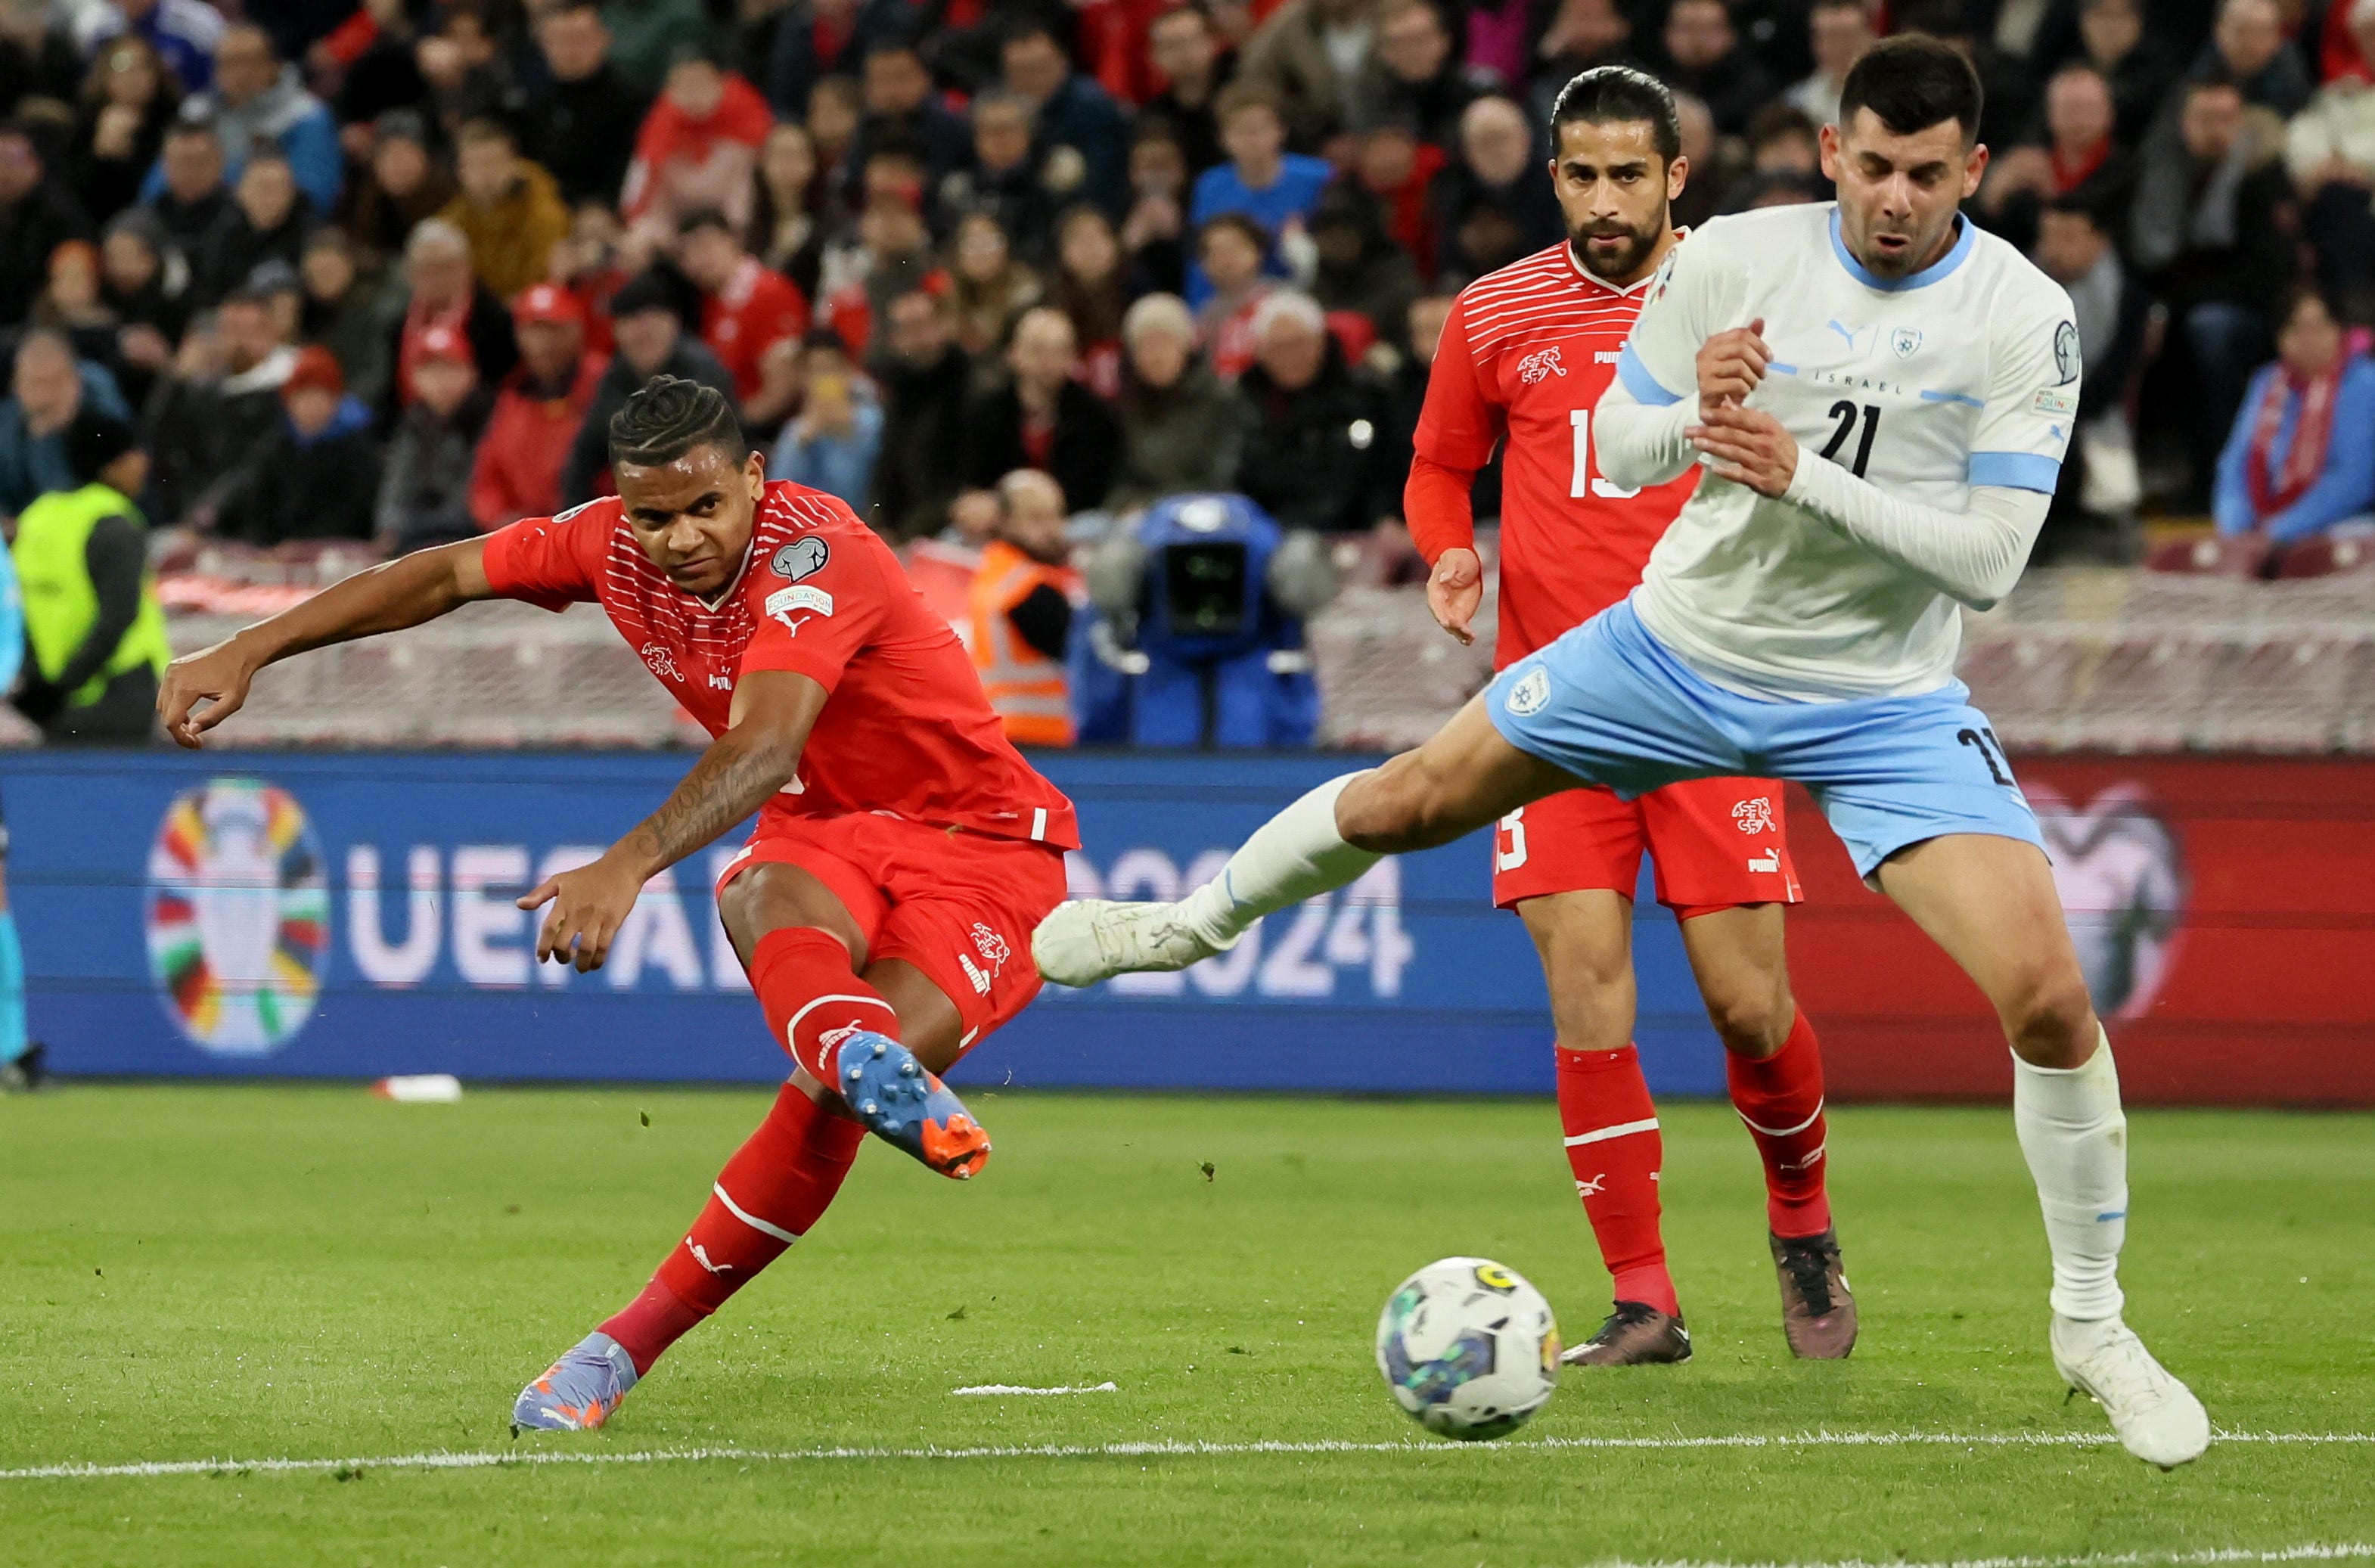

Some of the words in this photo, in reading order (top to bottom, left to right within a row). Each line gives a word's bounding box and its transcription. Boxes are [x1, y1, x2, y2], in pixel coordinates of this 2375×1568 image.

[1594, 351, 1622, 364] PUM
[1815, 369, 1902, 396] ISRAEL
[1569, 408, 1641, 498] 1
[1819, 399, 1882, 480] 21
[768, 592, 831, 611] FOUNDATION
[1748, 859, 1778, 873] PUMA
[958, 953, 986, 993] PUMA
